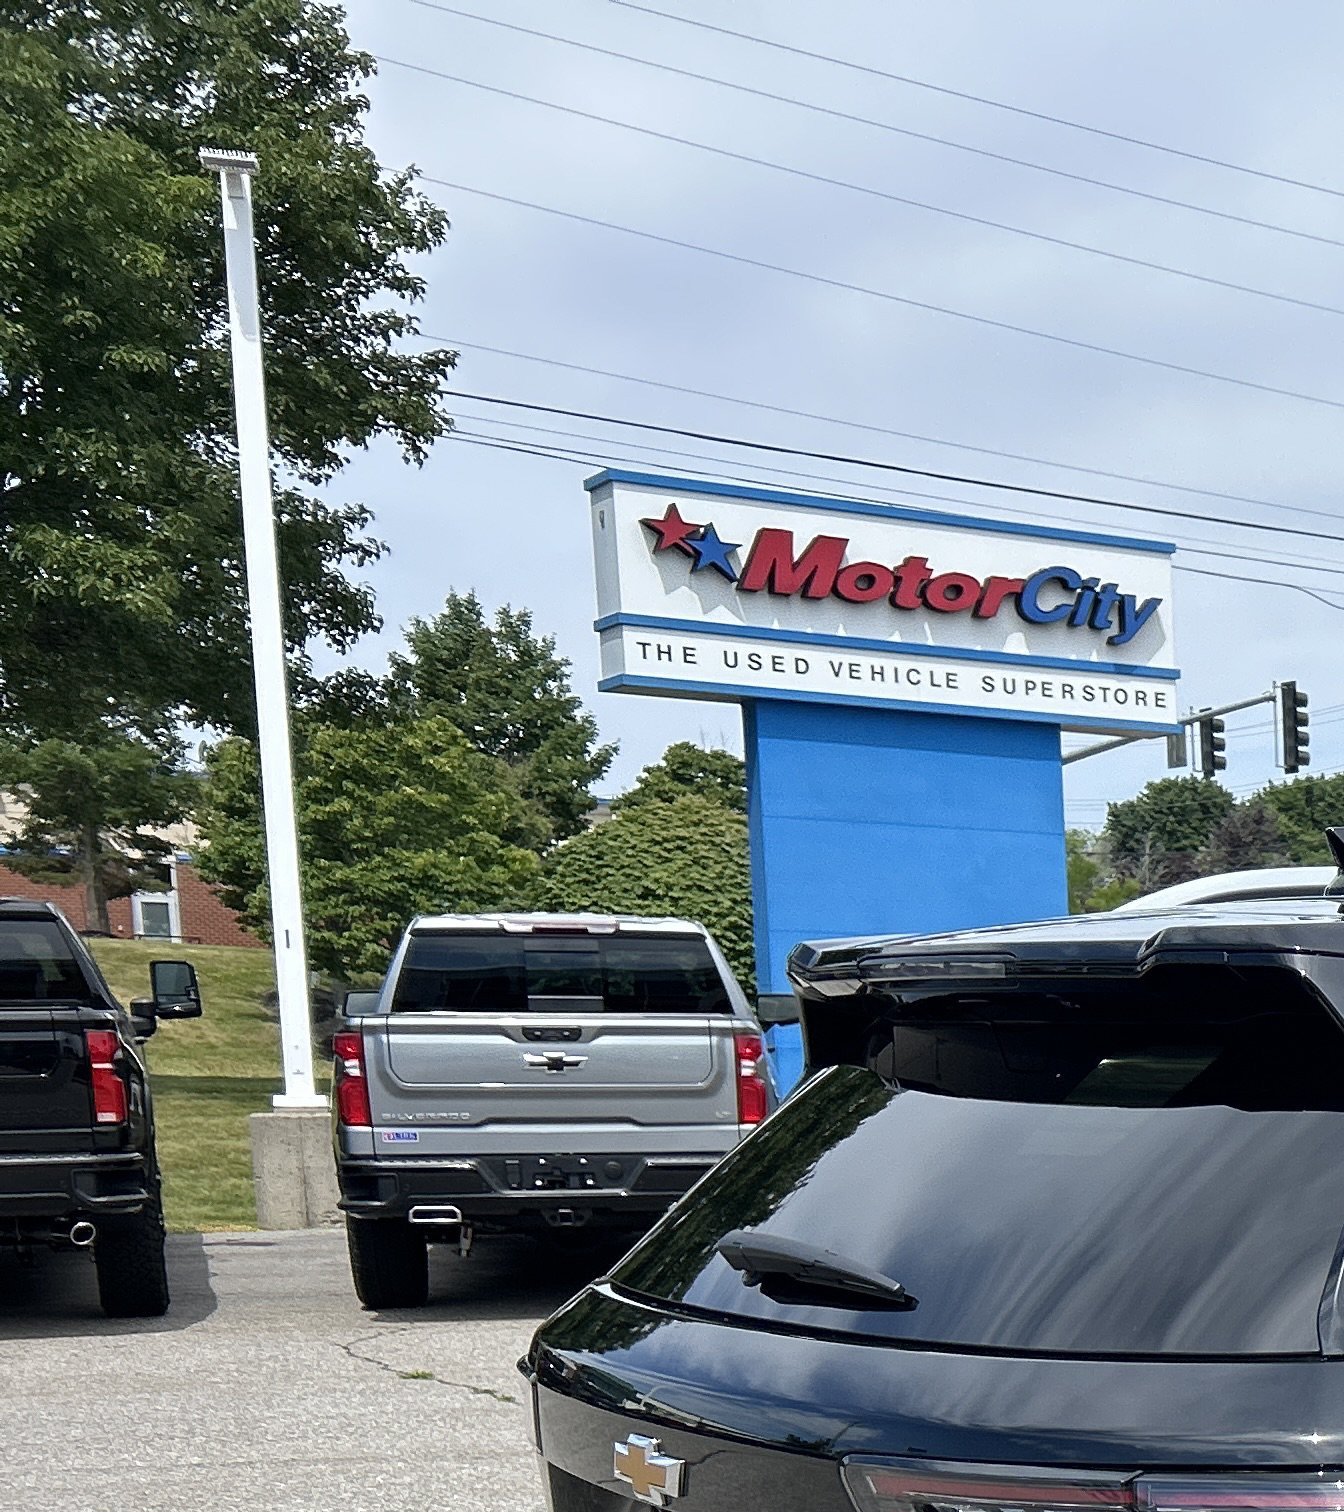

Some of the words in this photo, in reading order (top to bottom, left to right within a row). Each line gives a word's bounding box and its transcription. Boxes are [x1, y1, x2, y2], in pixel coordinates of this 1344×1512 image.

[735, 526, 1163, 647] MotorCity
[635, 641, 699, 666] THE
[722, 648, 811, 676] USED
[828, 659, 961, 691] VEHICLE
[981, 675, 1168, 710] SUPERSTORE
